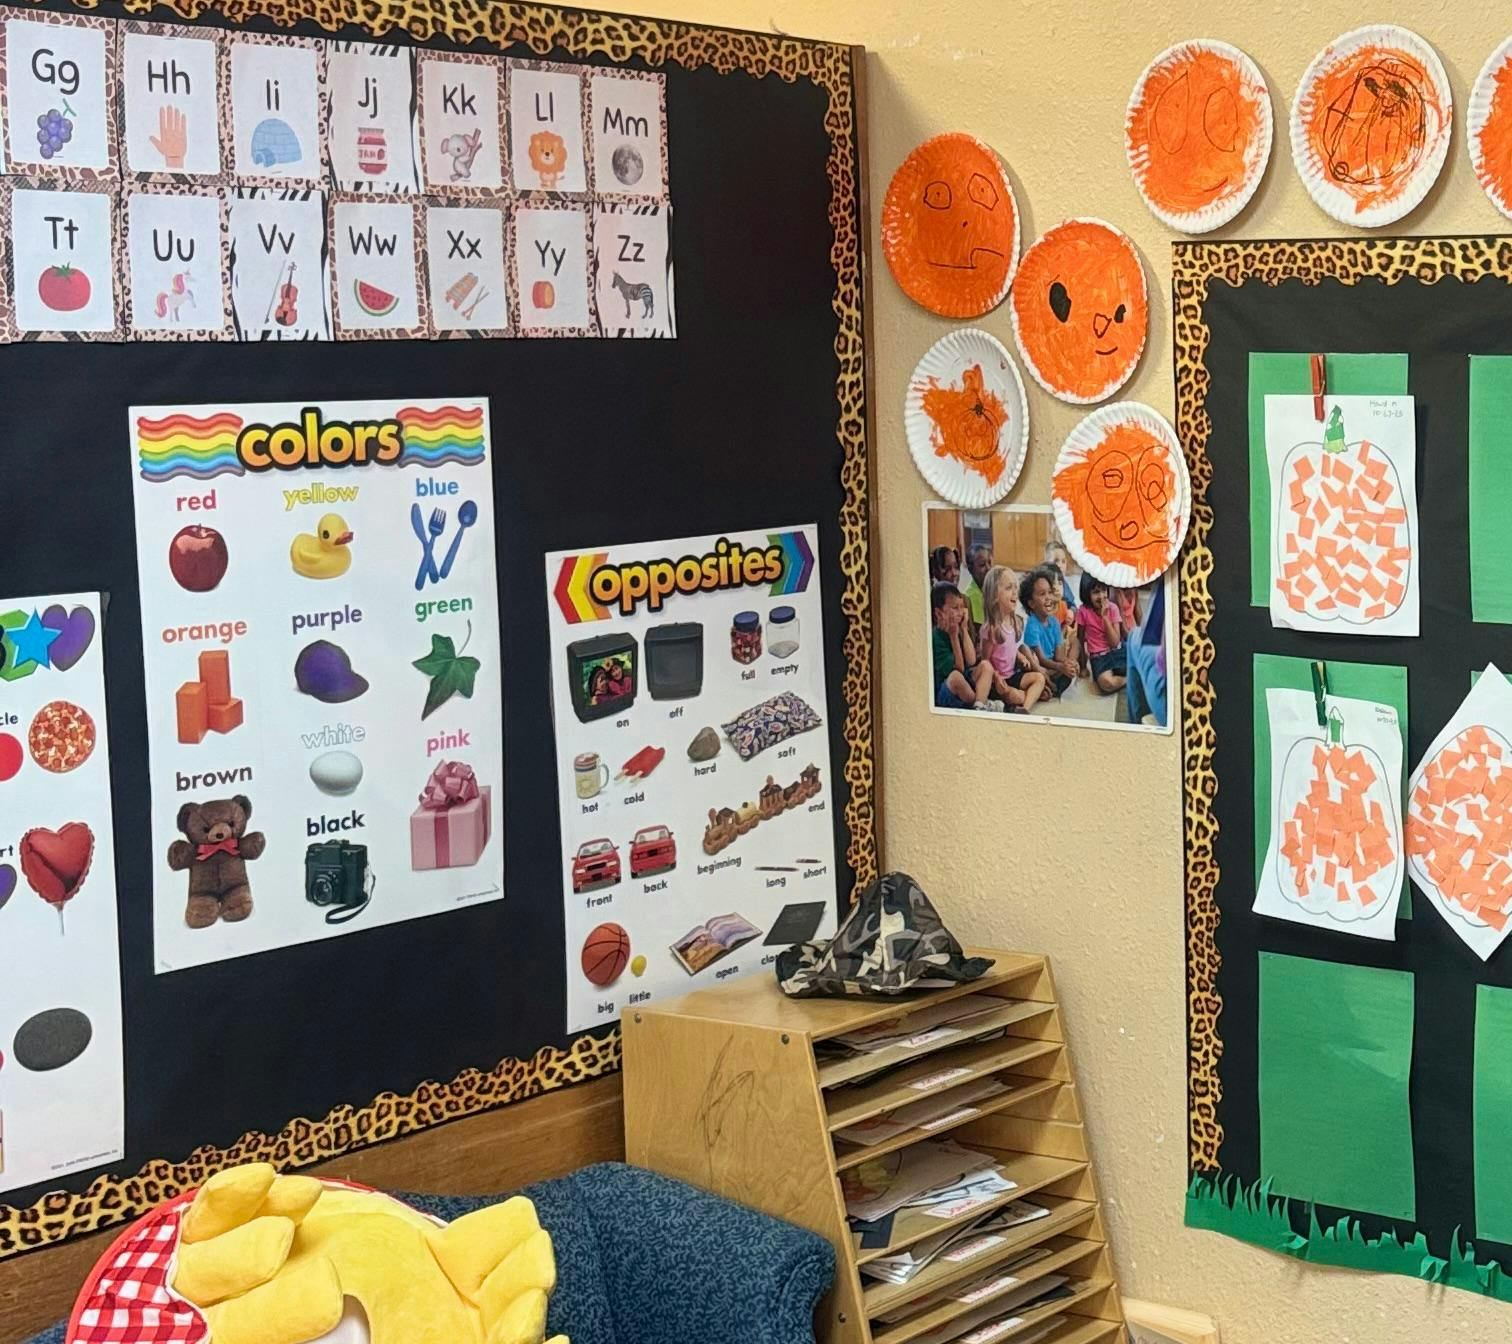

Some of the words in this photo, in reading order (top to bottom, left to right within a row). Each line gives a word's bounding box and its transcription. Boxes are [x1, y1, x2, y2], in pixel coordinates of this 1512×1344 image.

[31, 48, 81, 94] Gg
[147, 60, 192, 96] Hh
[265, 79, 281, 111] Ii
[357, 78, 379, 119] Jj
[442, 83, 479, 116] Kk
[535, 91, 555, 122] Ll
[602, 107, 650, 138] Mm
[43, 216, 80, 251] Tt
[152, 229, 195, 263] Uu
[258, 223, 296, 255] Vv
[348, 225, 398, 257] Ww
[446, 230, 483, 260] Xx
[534, 239, 568, 276] Yy
[617, 234, 646, 263] Zz
[238, 408, 404, 470] colors
[176, 490, 217, 511] red
[283, 482, 360, 511] yellow
[416, 478, 459, 497] blue
[590, 539, 783, 614] opposites
[292, 604, 363, 634] purple
[414, 594, 473, 622] green
[162, 618, 248, 644] orange
[740, 669, 756, 681] full
[770, 663, 800, 676] empty
[616, 717, 630, 728] on
[669, 707, 684, 719] off
[301, 723, 366, 750] white
[426, 728, 471, 757] pink
[777, 746, 796, 759] soft
[175, 766, 254, 792] brown
[694, 763, 717, 777] hard
[582, 802, 599, 814] hot
[623, 791, 645, 805] cold
[807, 801, 825, 813] end
[305, 809, 366, 837] black
[697, 855, 742, 875] beginning
[802, 866, 827, 880] short
[643, 879, 668, 894] back
[765, 877, 786, 889] long
[586, 894, 613, 908] front
[715, 965, 739, 980] open
[597, 1001, 615, 1014] big
[629, 990, 652, 1005] little
